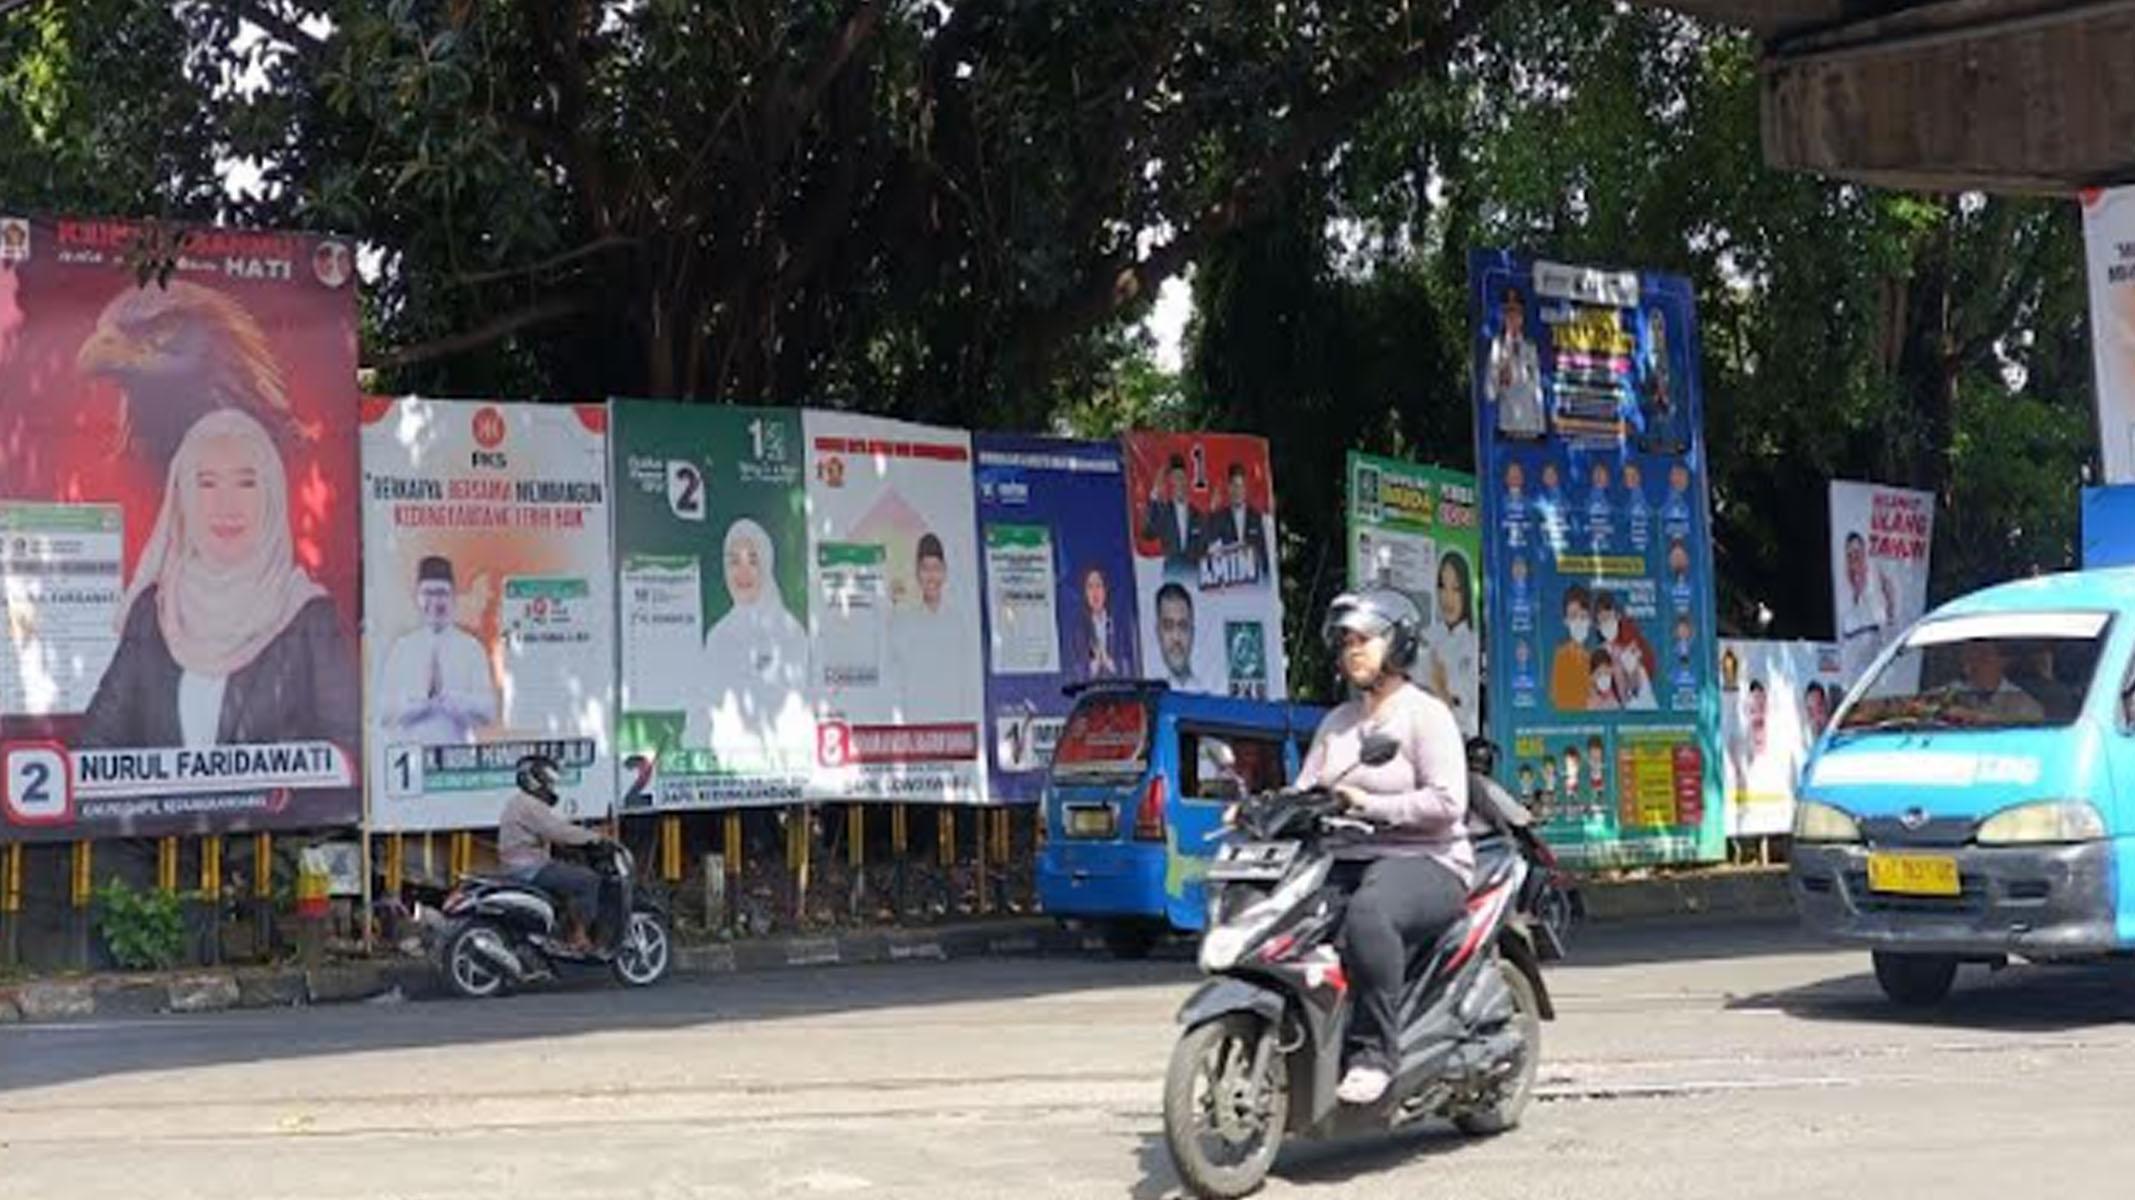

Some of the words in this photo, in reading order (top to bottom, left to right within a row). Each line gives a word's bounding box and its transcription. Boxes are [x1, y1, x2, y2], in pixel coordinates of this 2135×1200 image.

[225, 256, 291, 280] HATI
[472, 451, 508, 469] PKS
[675, 467, 699, 512] 2
[20, 762, 50, 803] 2
[80, 752, 169, 782] NURUL
[176, 748, 332, 778] FARIDAWATI
[394, 752, 410, 791] 1
[623, 754, 653, 807] 2
